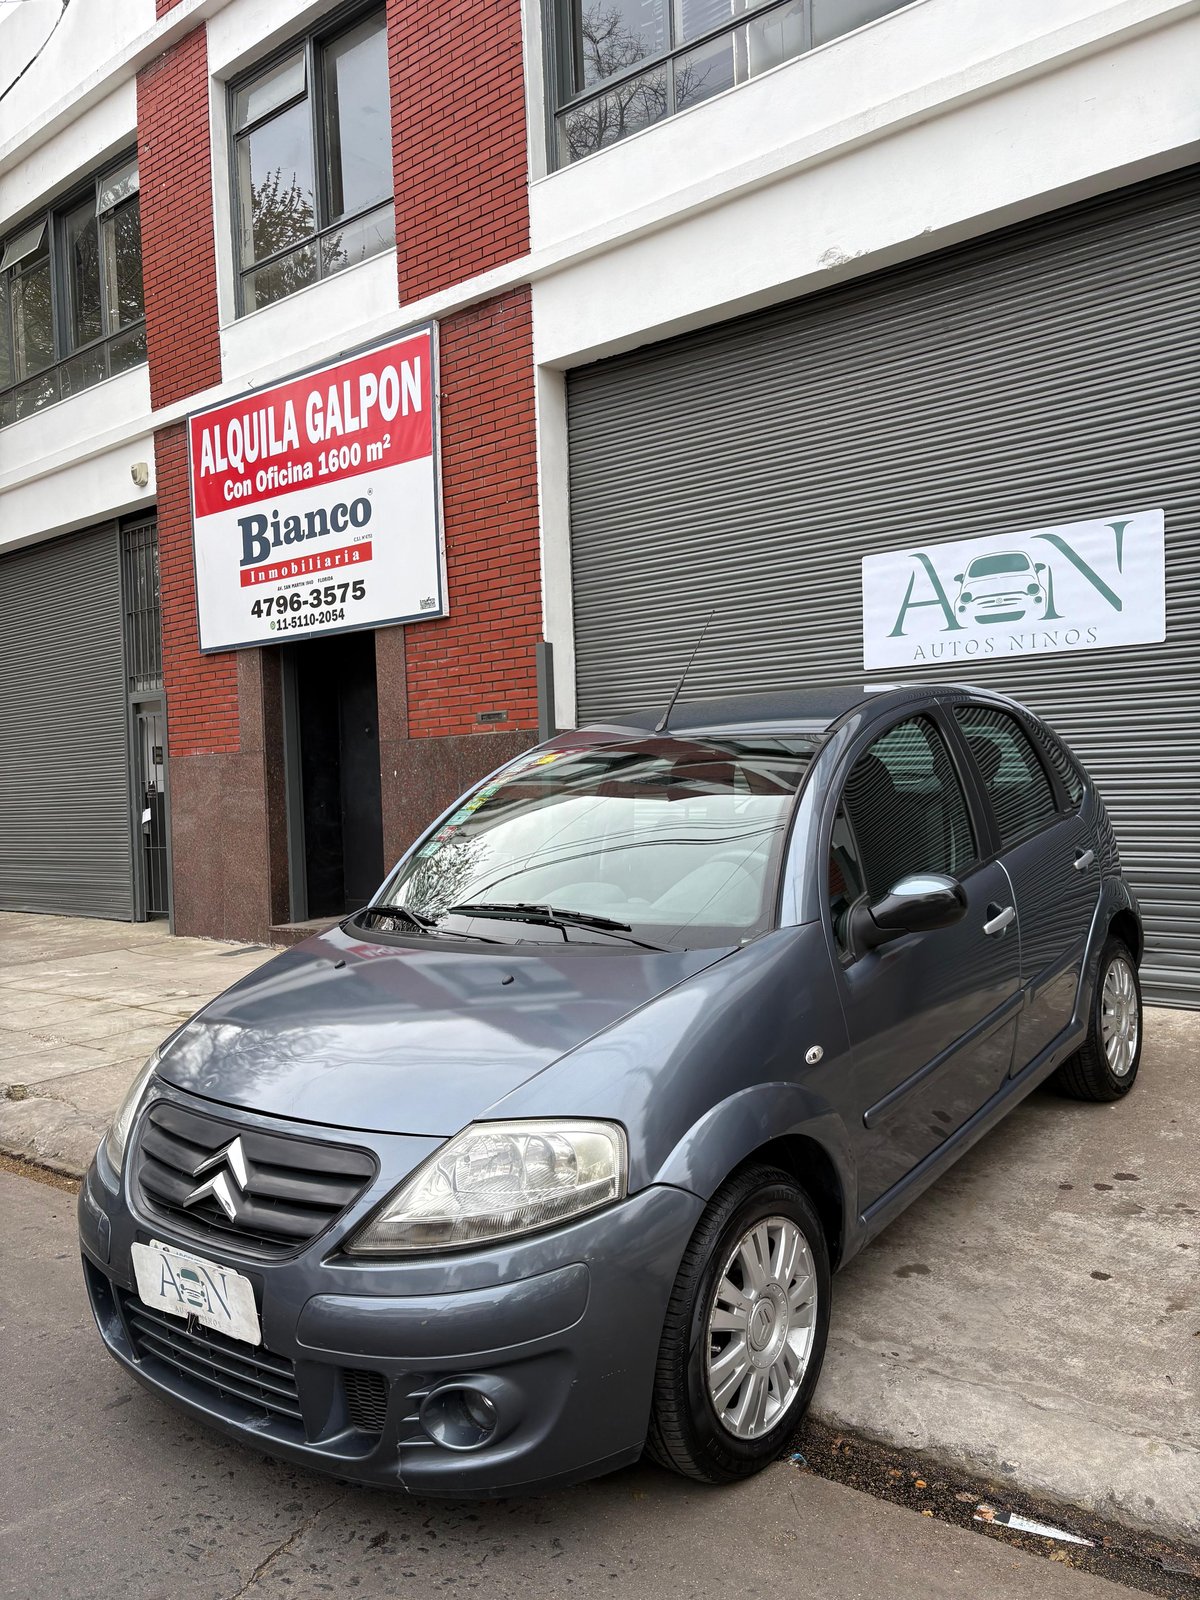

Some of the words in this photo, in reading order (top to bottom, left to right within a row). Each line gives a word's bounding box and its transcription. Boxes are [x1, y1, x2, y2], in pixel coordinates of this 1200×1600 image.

[200, 399, 299, 478] ALQUILA
[305, 356, 422, 445] GALPON
[223, 478, 252, 502] Con
[256, 461, 313, 493] Oficina
[318, 441, 361, 476] 1600
[237, 496, 372, 567] Bianco
[250, 549, 361, 584] Inmobiliaria
[251, 579, 366, 618] 4796-3575
[276, 607, 345, 631] 11-5110-2054
[913, 636, 995, 661] AUTOS
[1008, 626, 1098, 652] NINOS
